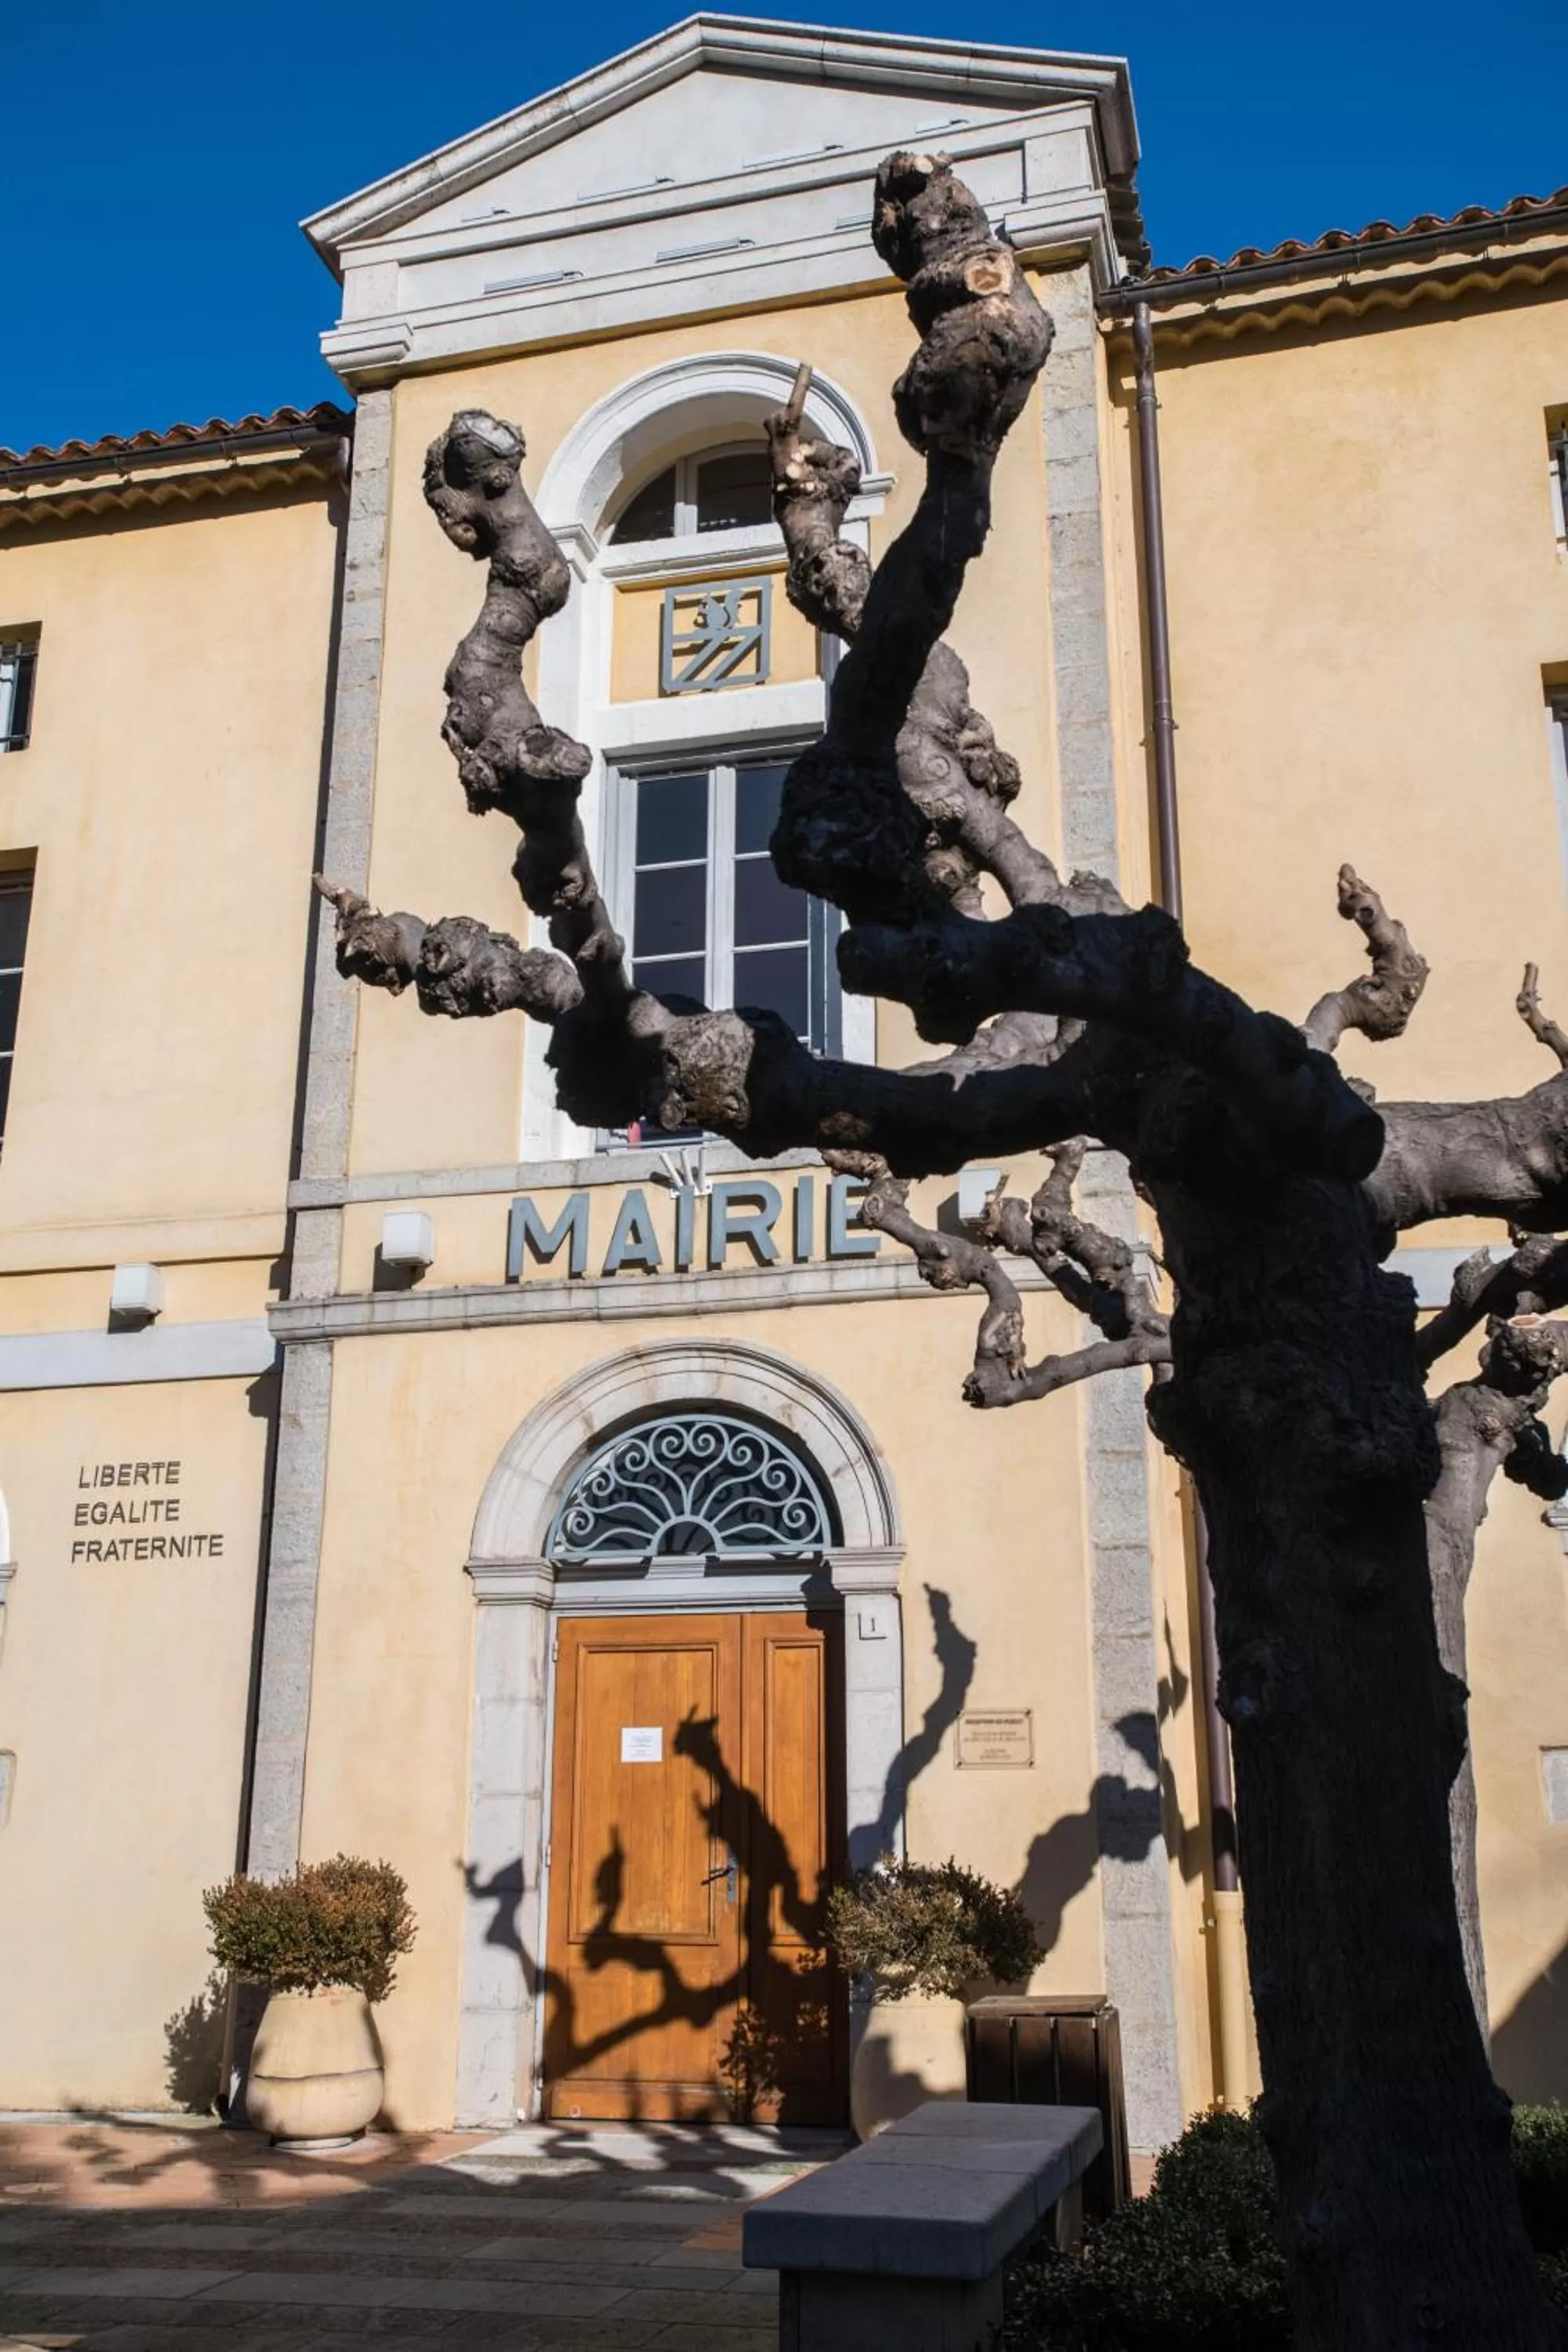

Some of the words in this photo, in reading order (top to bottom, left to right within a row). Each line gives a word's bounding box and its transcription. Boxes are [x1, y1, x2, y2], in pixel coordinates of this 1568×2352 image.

[508, 1174, 881, 1277] MAIRIE
[78, 1461, 181, 1489] LIBERTE
[74, 1498, 180, 1526] EGALITE
[71, 1534, 224, 1564] FRATERNITE
